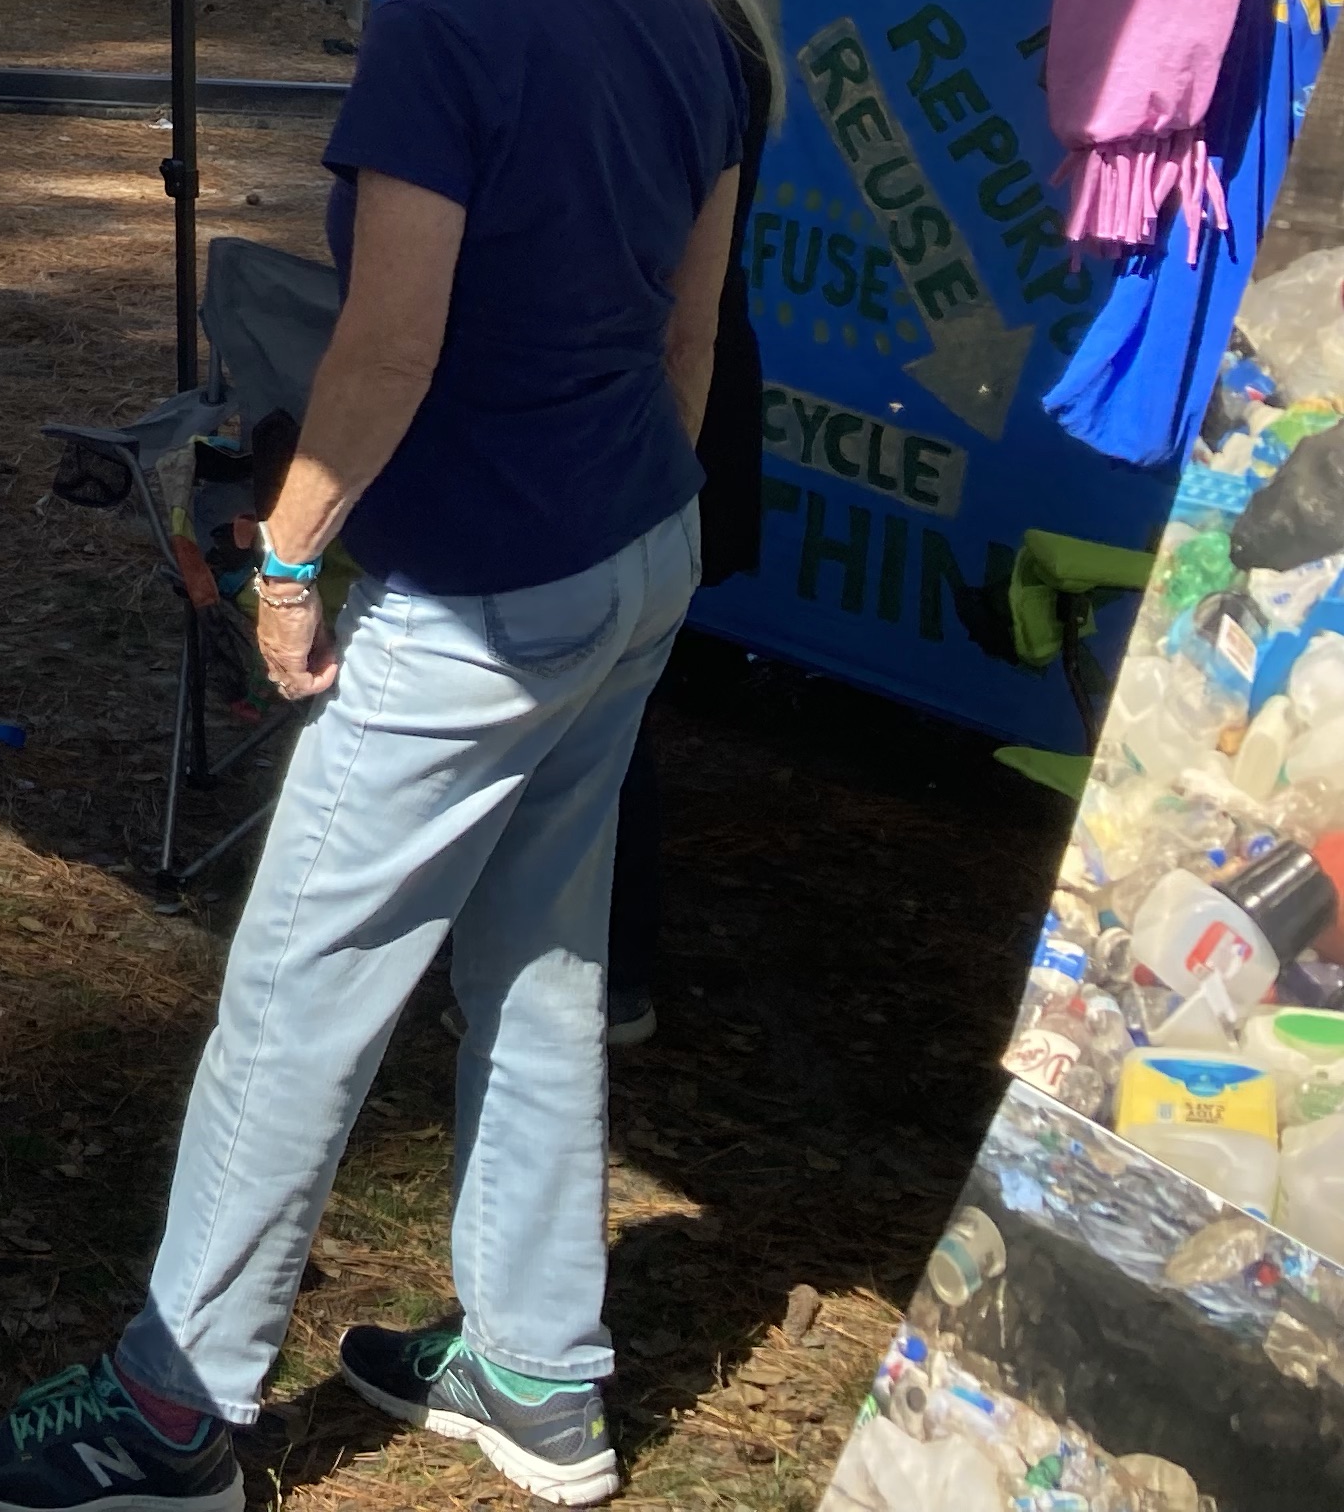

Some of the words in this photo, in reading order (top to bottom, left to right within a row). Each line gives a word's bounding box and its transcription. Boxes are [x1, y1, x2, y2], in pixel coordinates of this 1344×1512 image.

[741, 208, 893, 325] FUSE
[810, 34, 979, 322] REUSE
[887, 3, 1094, 356] REPURPO
